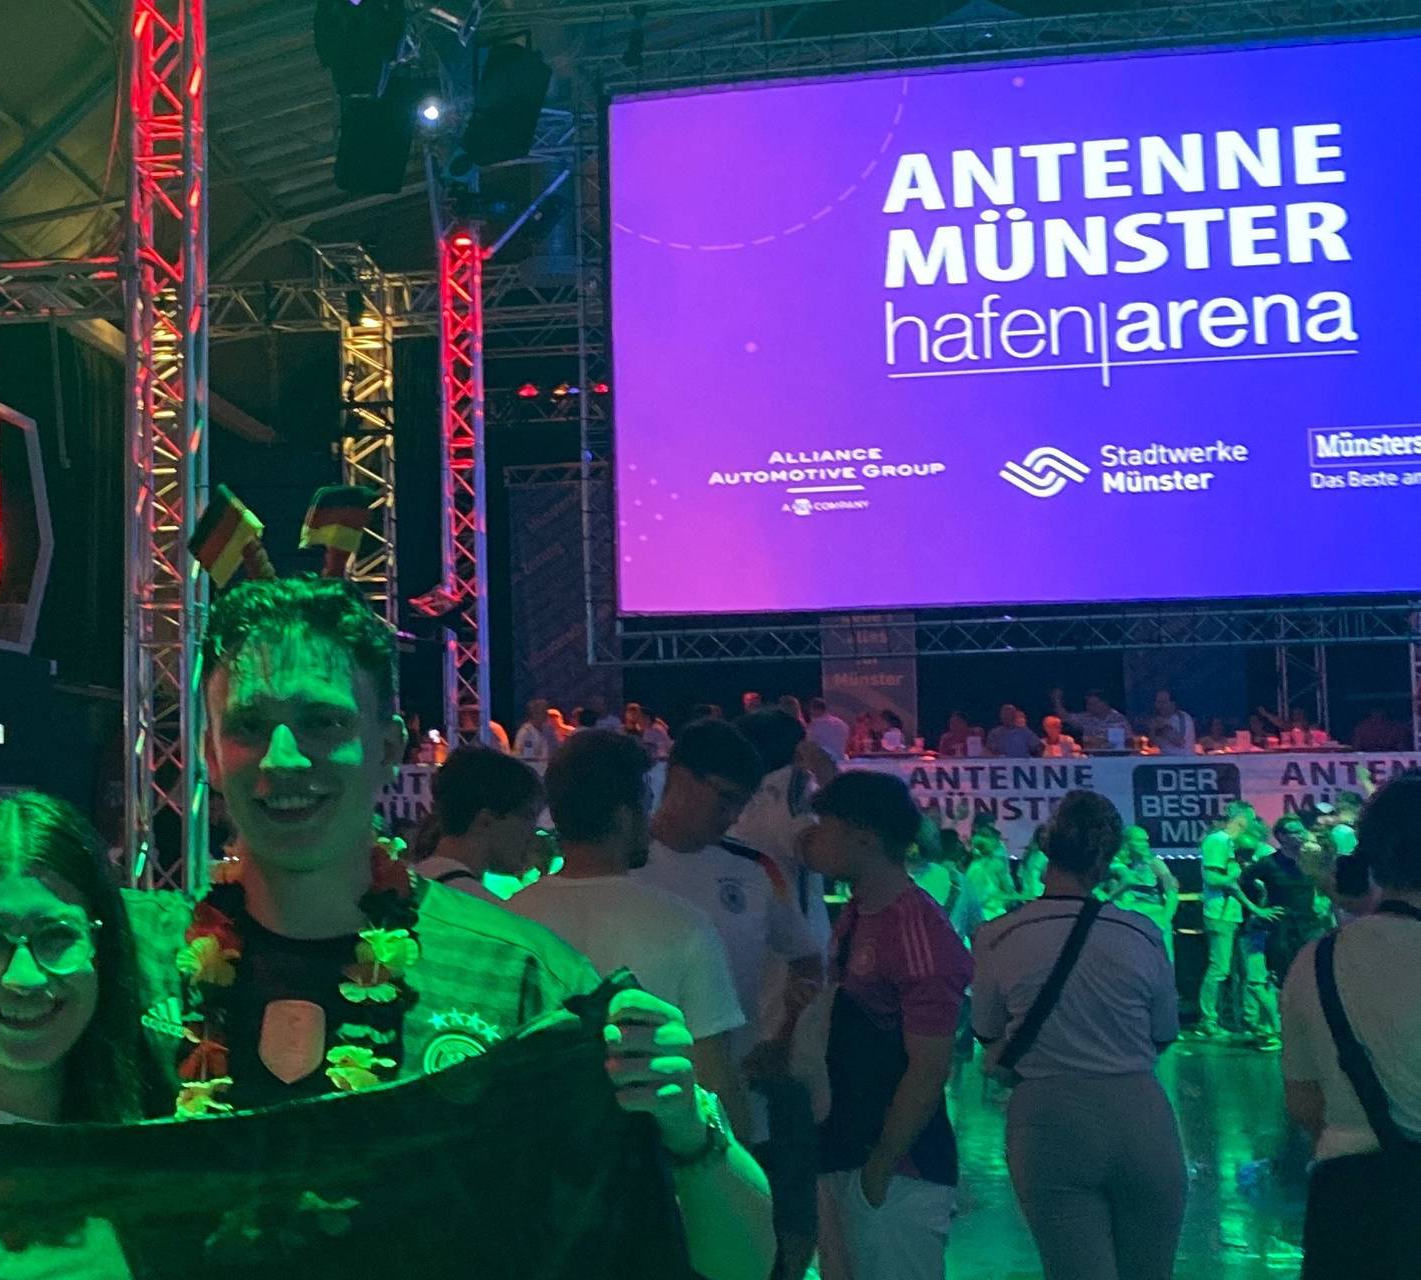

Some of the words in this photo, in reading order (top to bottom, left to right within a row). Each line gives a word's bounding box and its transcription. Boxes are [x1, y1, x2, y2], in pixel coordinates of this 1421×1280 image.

[882, 123, 1346, 213] ANTENNE
[884, 201, 1353, 289] MÜNSTER
[769, 448, 883, 464] ALLIANCE
[1100, 439, 1249, 467] Stadtwerke
[708, 467, 856, 485] AUTOMOTIVE
[862, 463, 946, 478] GROUP
[1102, 470, 1215, 493] Münster
[1310, 471, 1346, 489] Das
[1347, 470, 1399, 487] Beste
[909, 765, 1095, 790] ANTENNE
[1156, 768, 1219, 791] DER
[1141, 793, 1235, 817] BESTE
